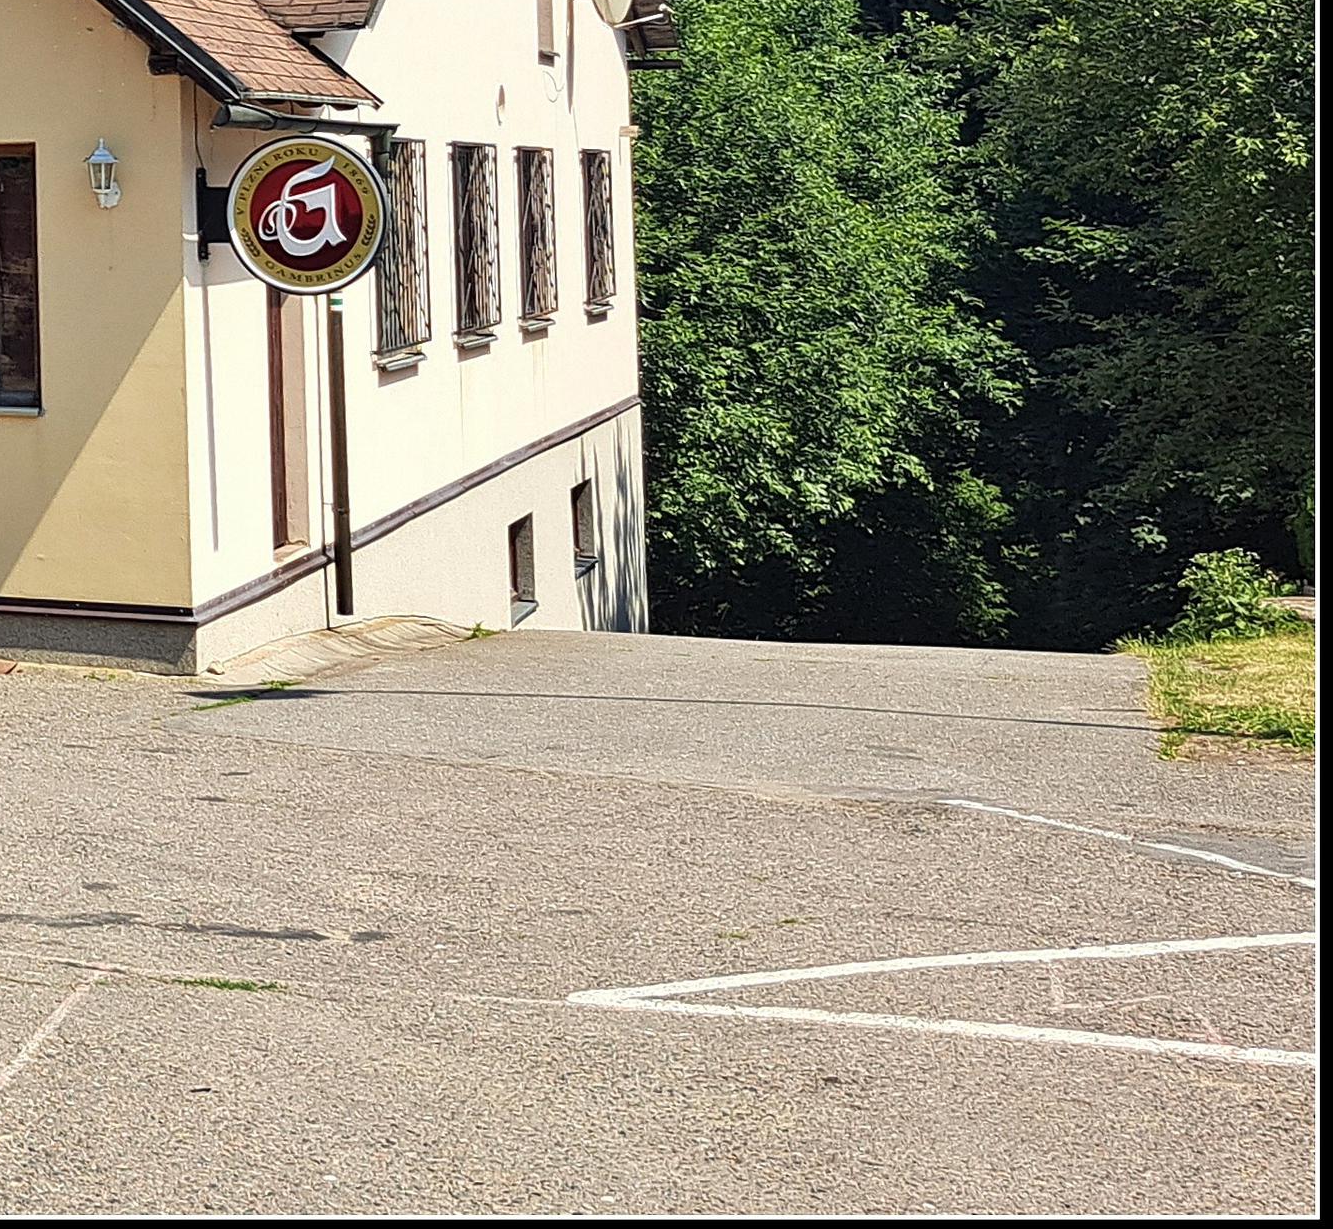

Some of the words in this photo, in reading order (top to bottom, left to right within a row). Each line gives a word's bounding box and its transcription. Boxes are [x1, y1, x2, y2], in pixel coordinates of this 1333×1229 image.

[274, 146, 319, 162] ROKU
[342, 161, 369, 196] 1869
[264, 252, 362, 283] GAMBRINUS
